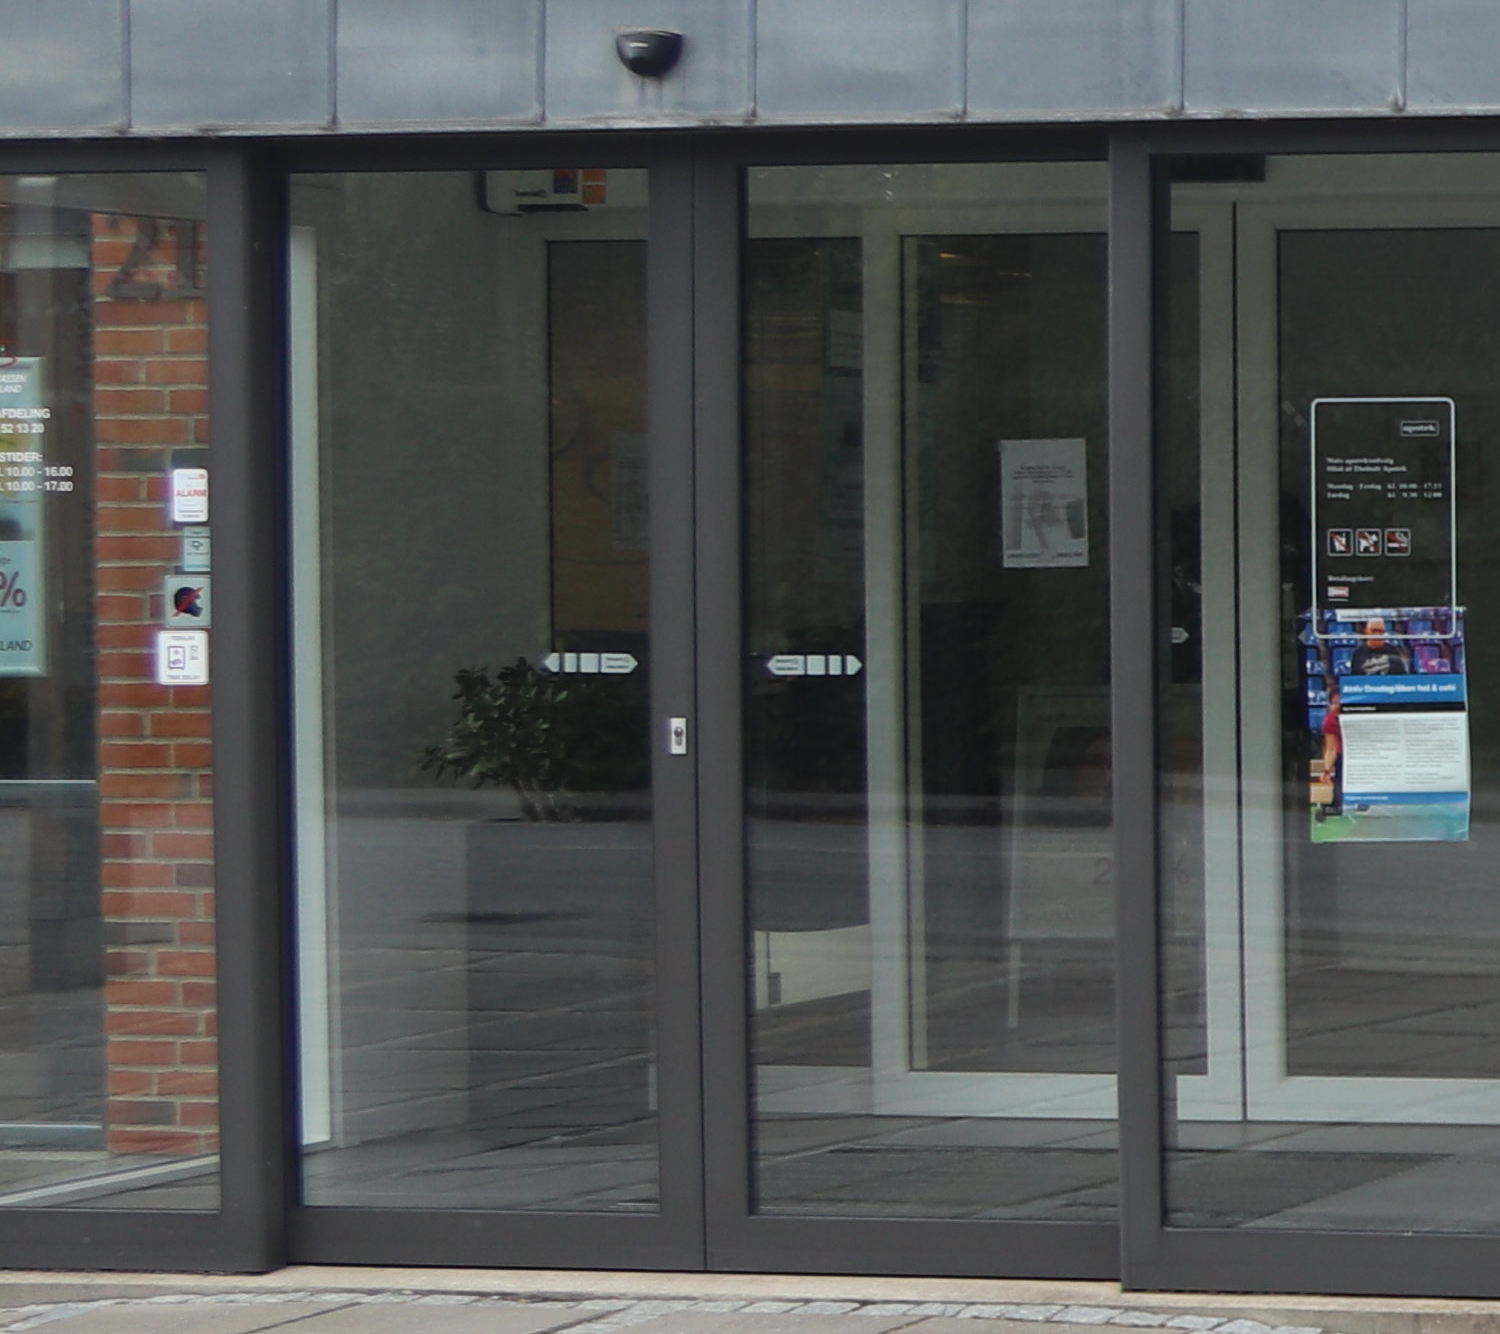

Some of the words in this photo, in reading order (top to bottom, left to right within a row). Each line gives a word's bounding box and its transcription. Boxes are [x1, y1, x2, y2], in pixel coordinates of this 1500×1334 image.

[1, 423, 14, 434] 52
[16, 423, 29, 434] 13
[31, 423, 45, 434] 20
[6, 466, 35, 477] 10.00
[45, 466, 74, 478] 16.00
[6, 481, 35, 492] 10.00
[45, 481, 74, 492] 17.00
[175, 489, 207, 497] ALARM
